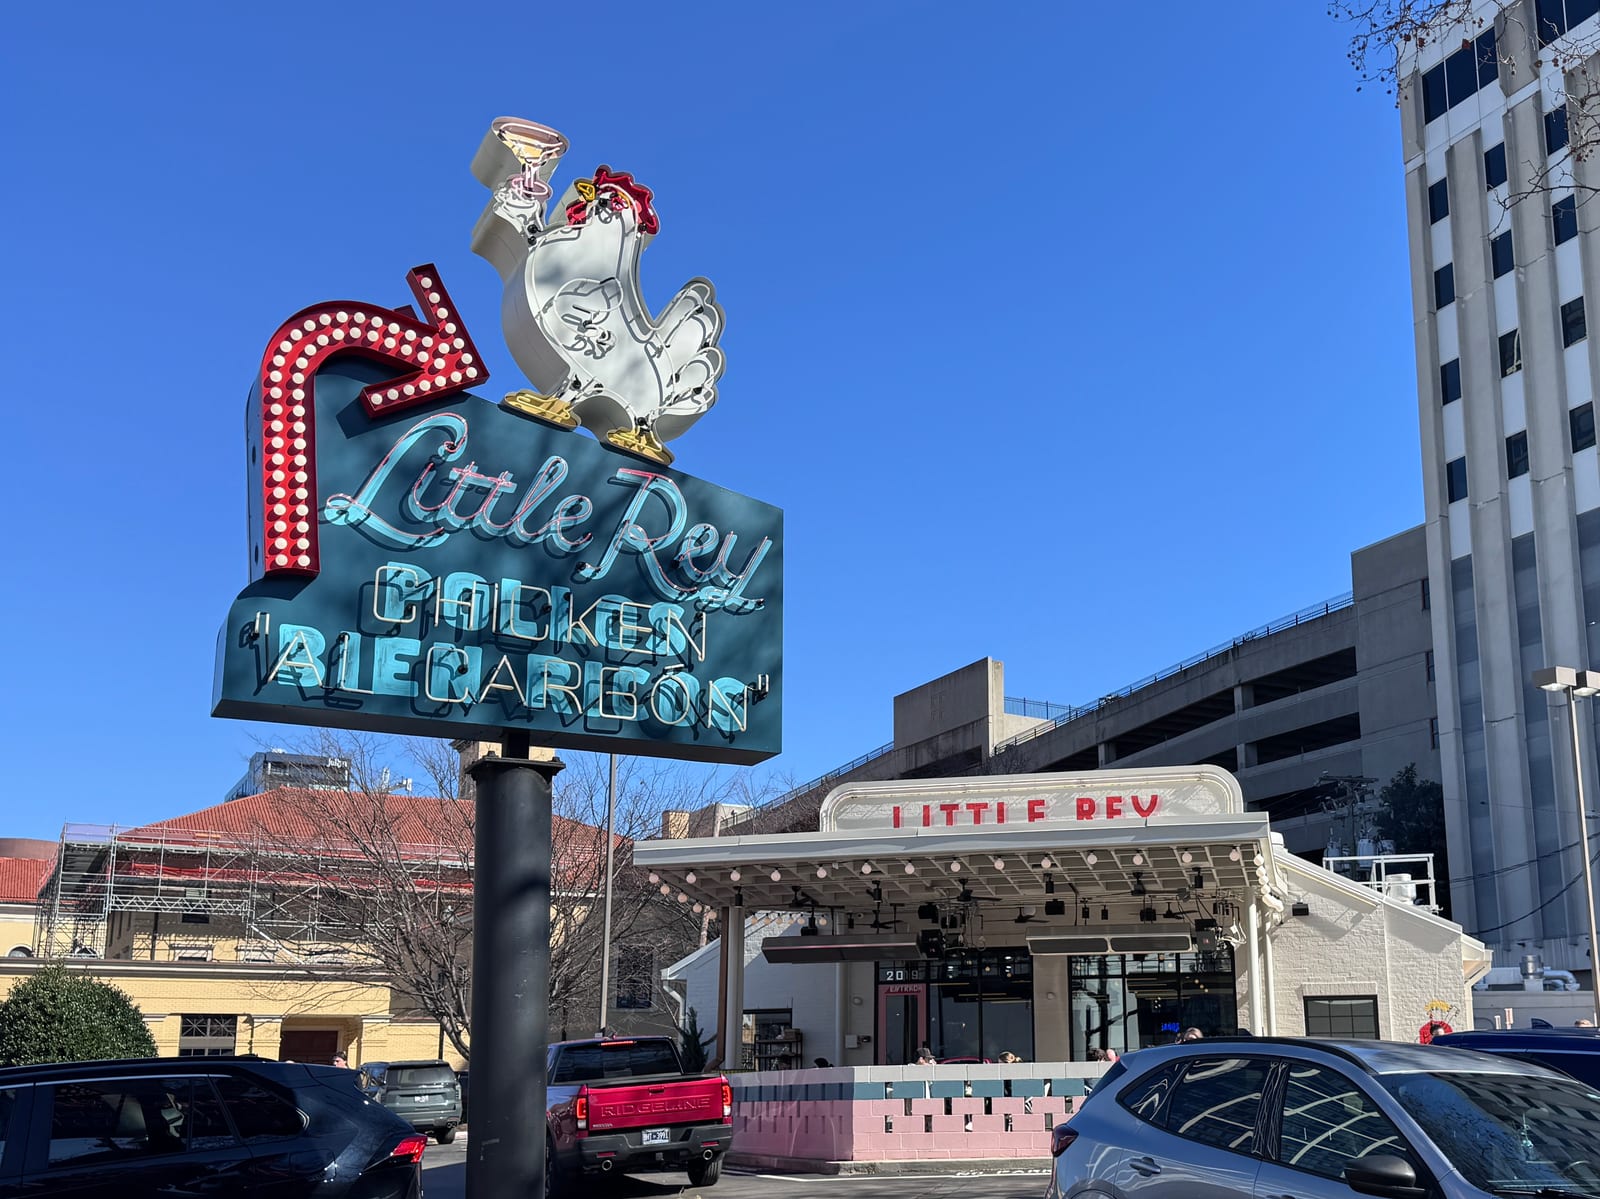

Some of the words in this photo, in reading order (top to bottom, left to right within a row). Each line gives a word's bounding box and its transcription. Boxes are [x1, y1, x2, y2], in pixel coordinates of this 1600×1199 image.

[323, 412, 593, 552] Little
[576, 467, 773, 612] Rey
[373, 565, 707, 662] CHICKEN
[601, 1098, 711, 1117] RIDGELINE
